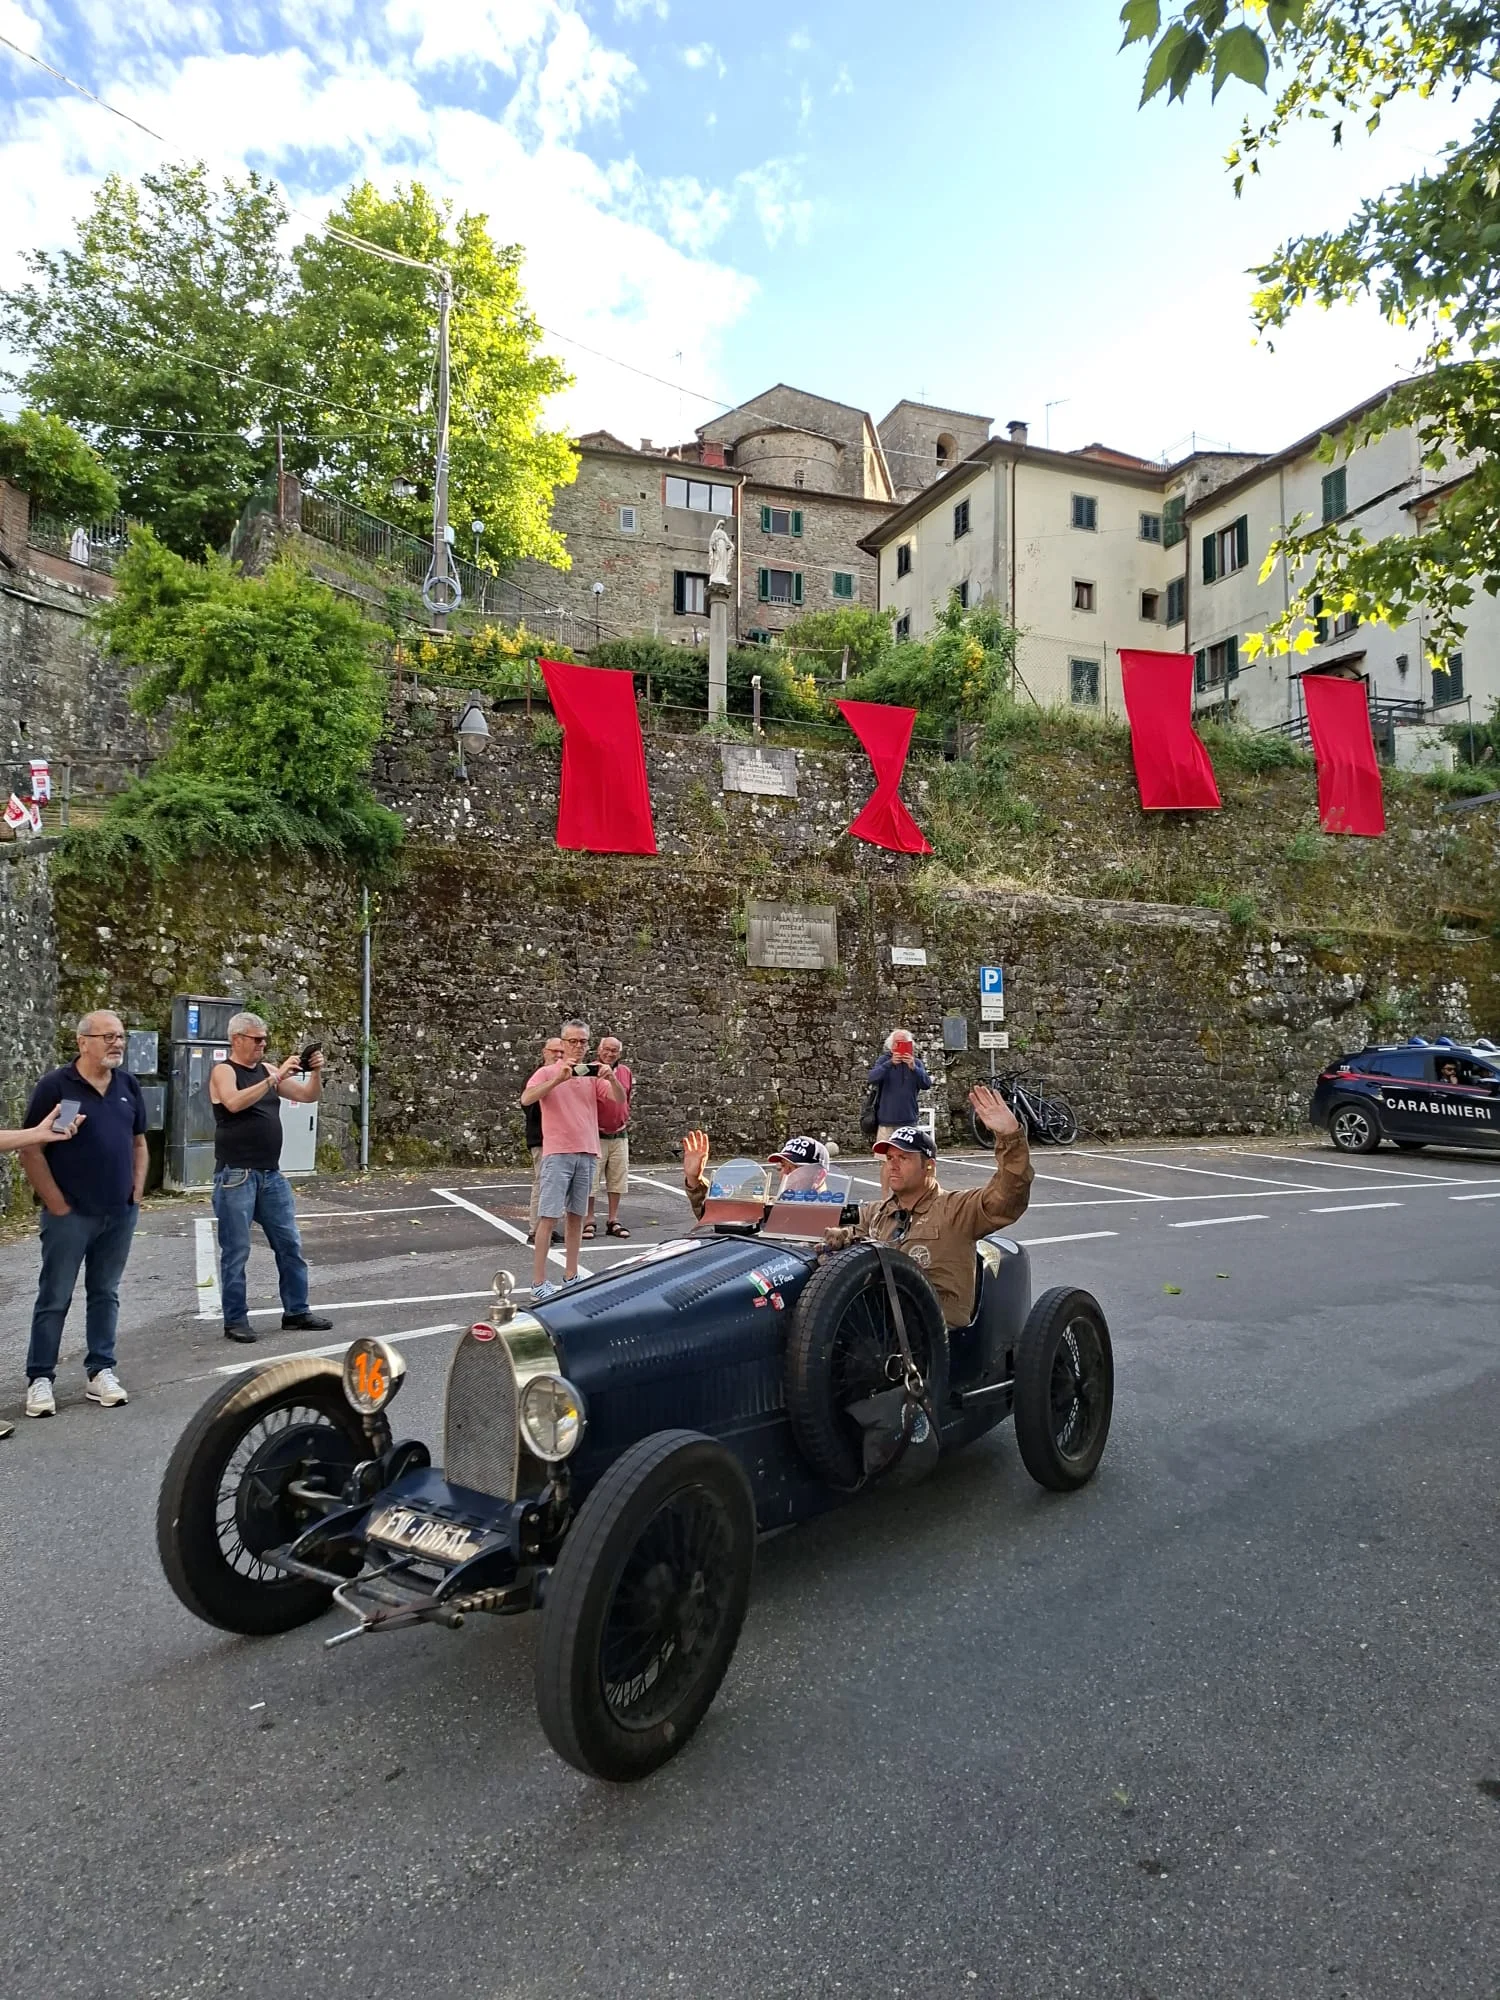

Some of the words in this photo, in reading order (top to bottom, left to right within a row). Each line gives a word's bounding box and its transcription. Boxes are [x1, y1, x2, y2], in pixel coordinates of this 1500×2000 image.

[985, 969, 999, 991] P
[1386, 1098, 1491, 1119] CARABINIERI
[355, 1352, 385, 1400] 16
